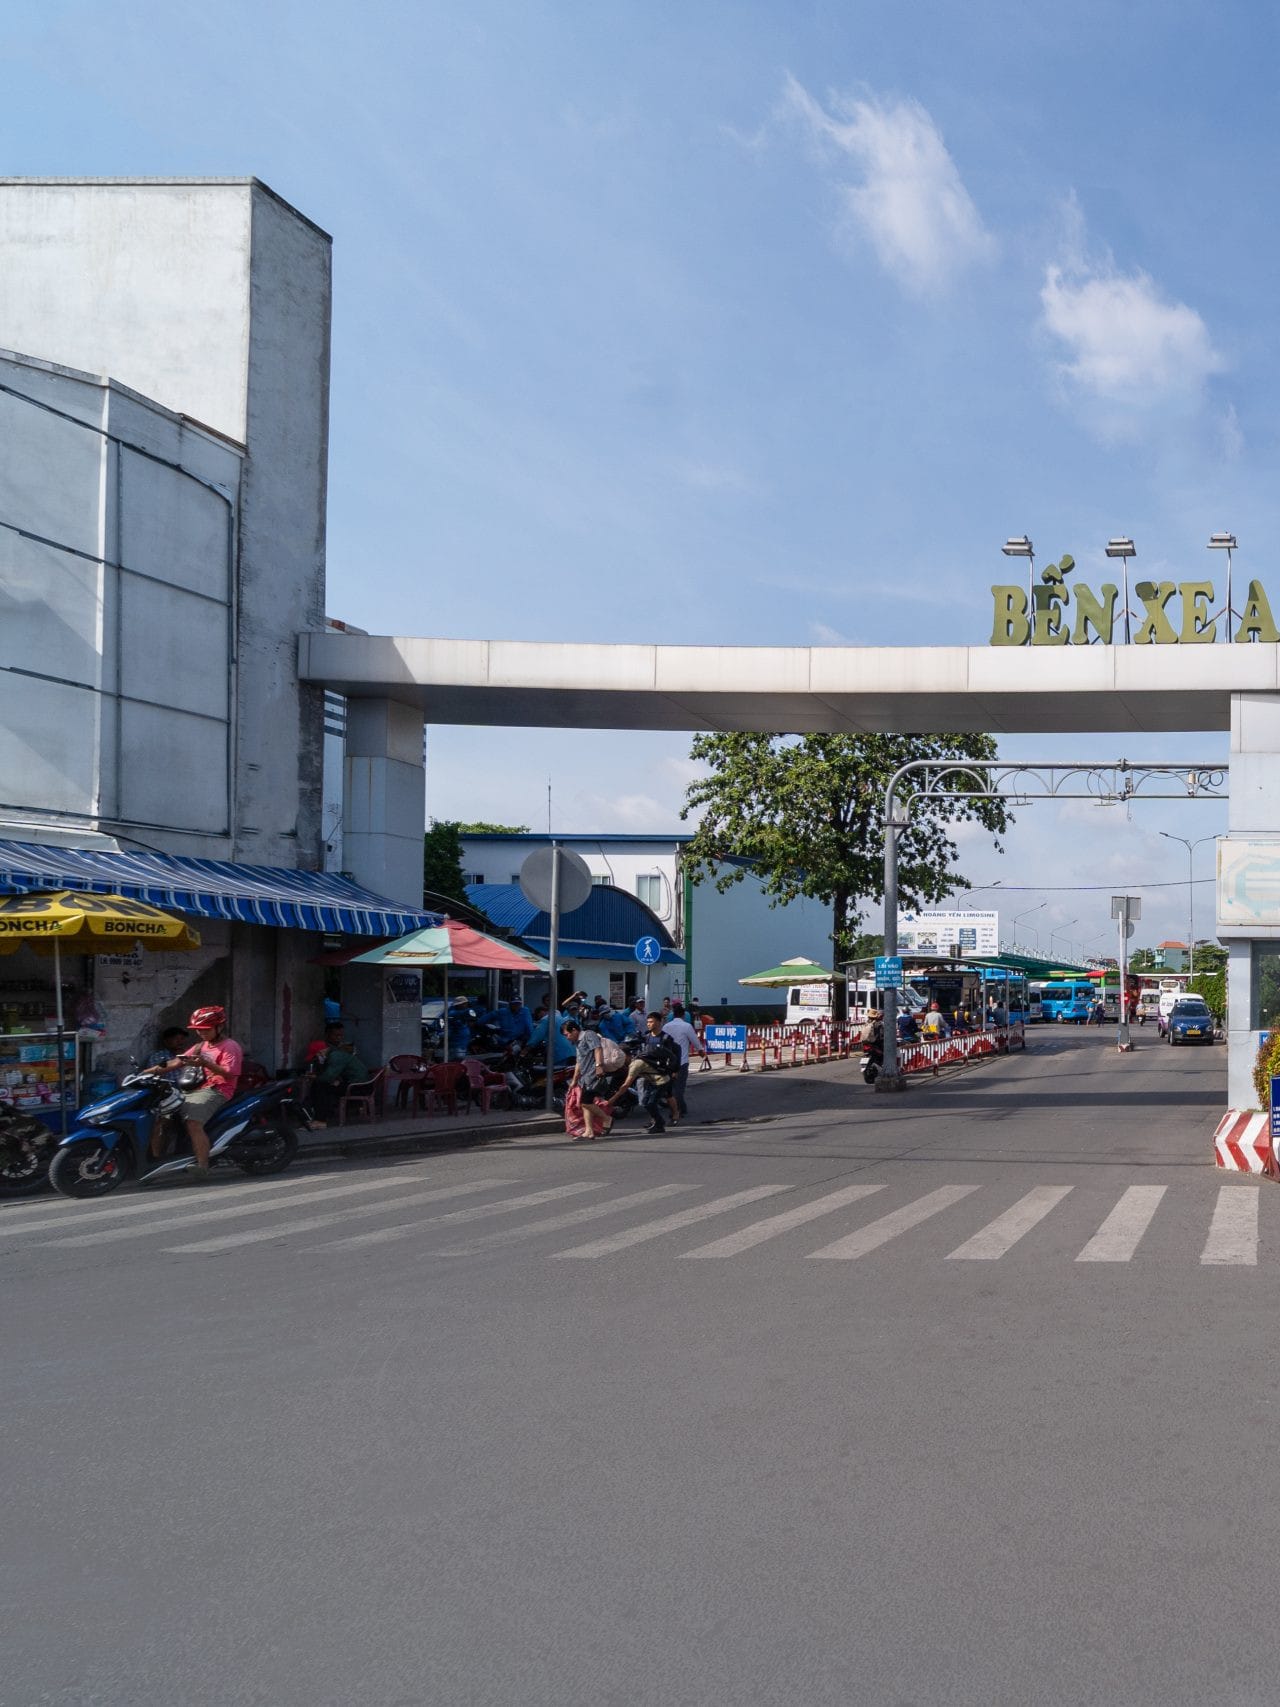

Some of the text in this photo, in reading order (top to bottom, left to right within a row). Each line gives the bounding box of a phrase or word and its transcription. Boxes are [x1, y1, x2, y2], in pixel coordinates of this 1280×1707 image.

[990, 554, 1118, 646] BẾN
[1134, 580, 1217, 645] XE
[104, 921, 167, 934] BONCHA
[715, 1026, 737, 1037] KHU VỰC
[737, 1041, 744, 1050] XE
